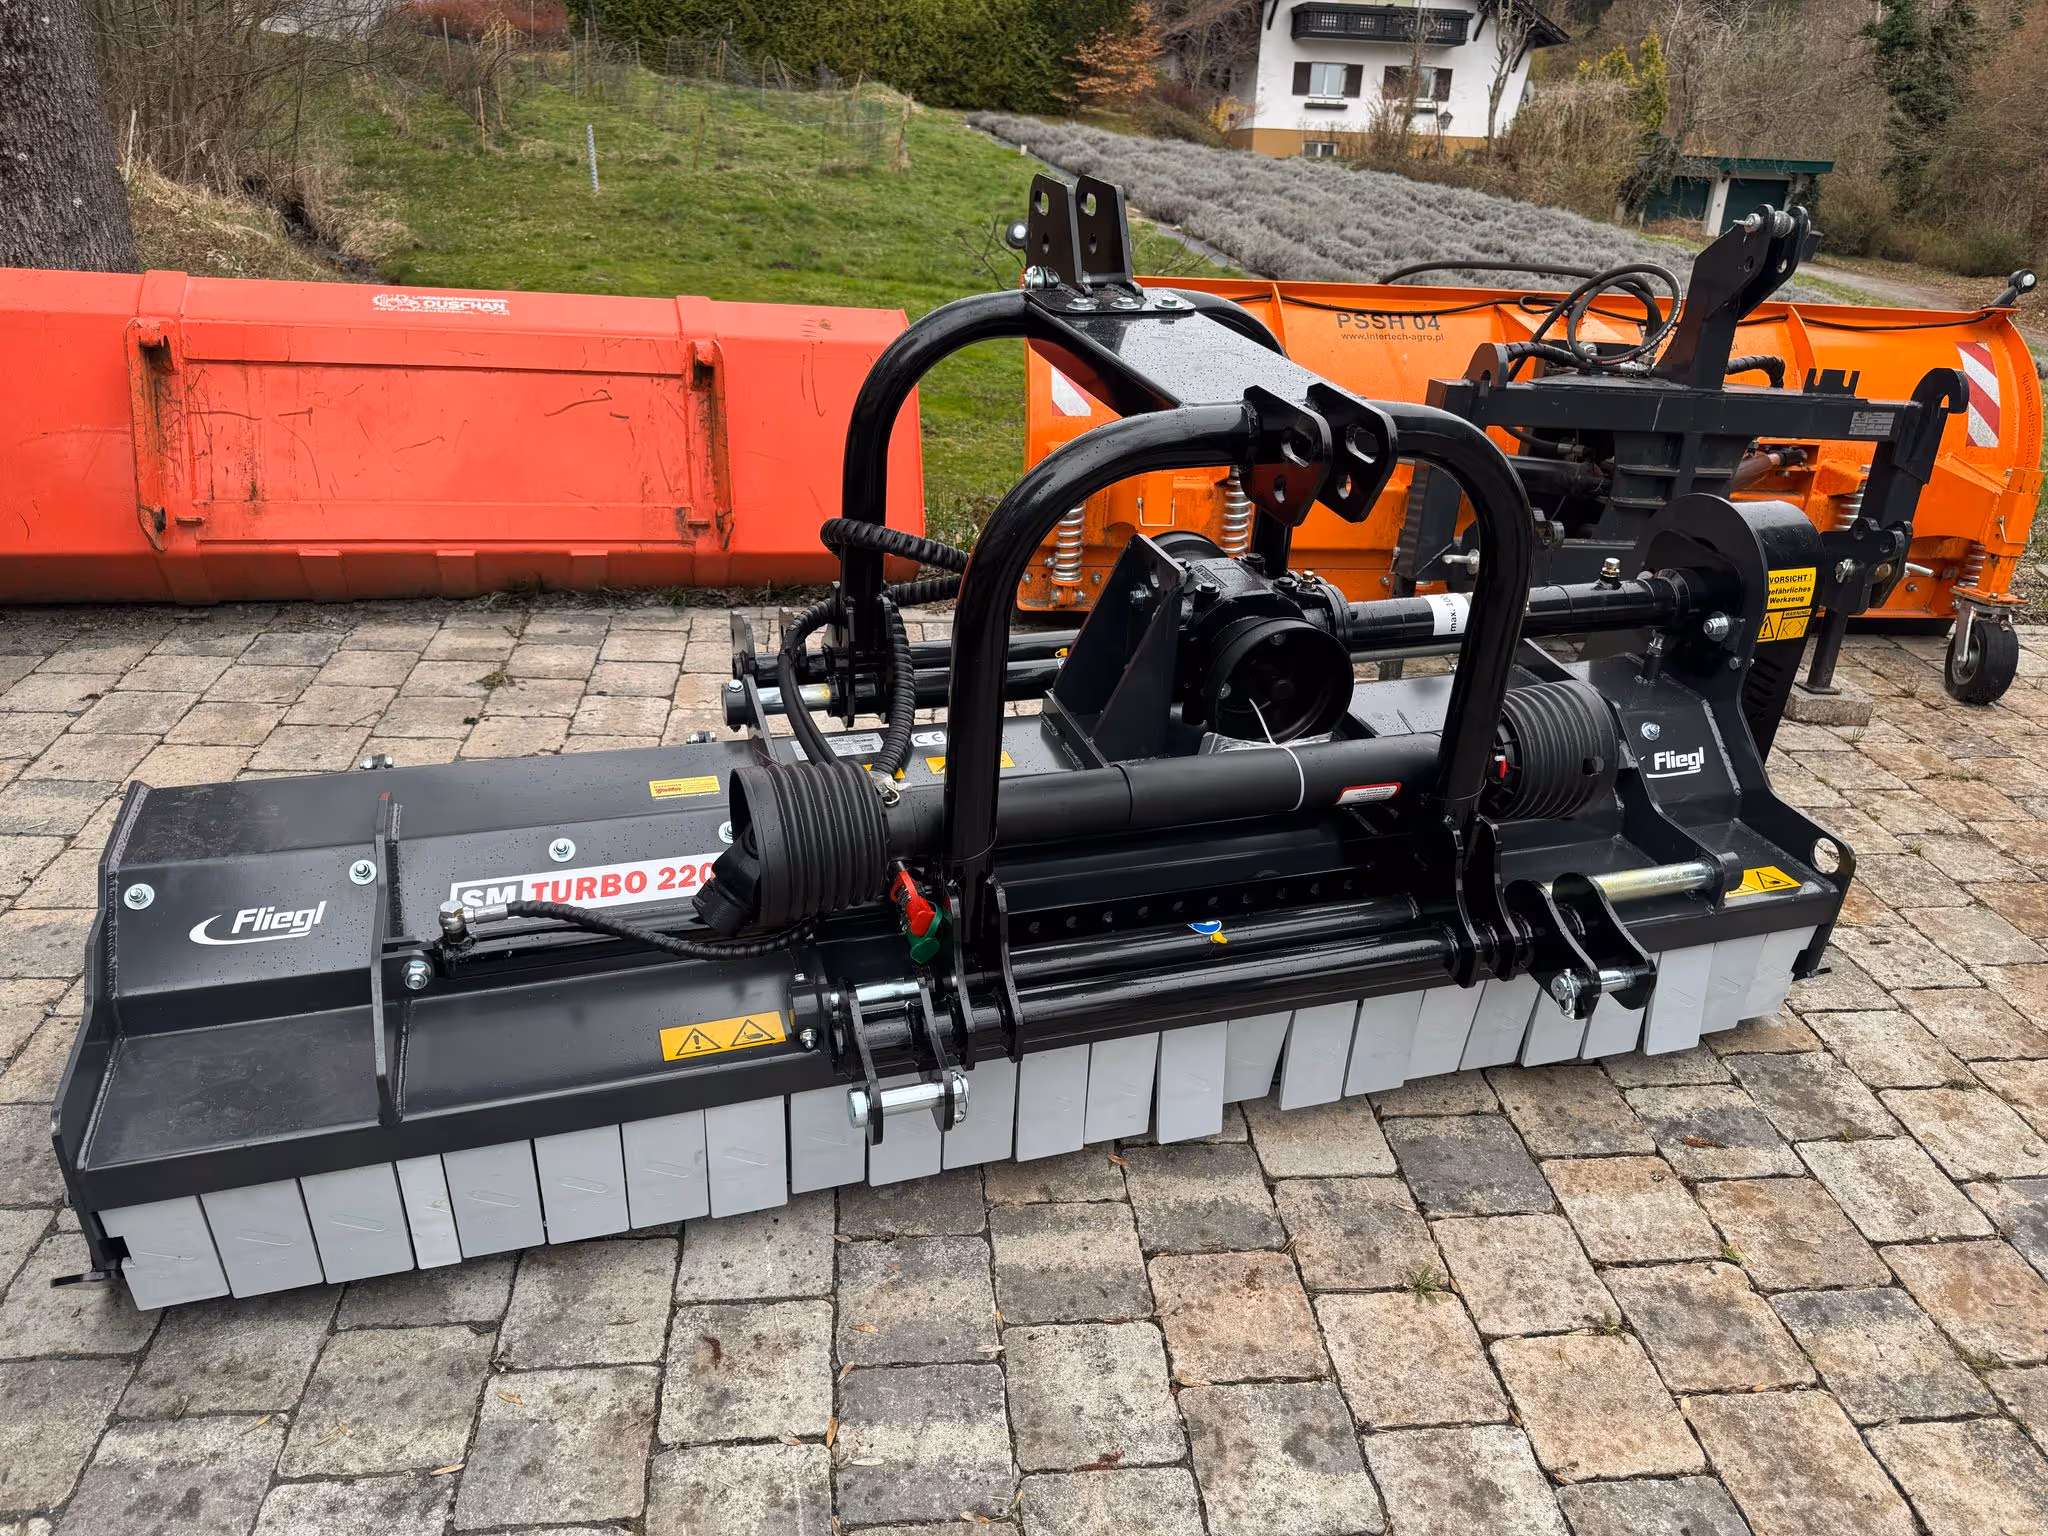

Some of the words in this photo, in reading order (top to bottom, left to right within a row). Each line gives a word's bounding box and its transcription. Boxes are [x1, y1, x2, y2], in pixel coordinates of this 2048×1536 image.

[1336, 313, 1405, 330] PSSH
[1413, 315, 1441, 331] 04
[1341, 332, 1445, 342] www.intertech-agro.pl
[1769, 574, 1808, 584] VORSICHT
[1769, 595, 1805, 604] Werkzeug
[1653, 746, 1705, 771] Fliegl
[461, 884, 518, 908] SM
[531, 870, 648, 904] TURBO
[657, 861, 716, 891] 220
[231, 900, 327, 934] Fliegl
